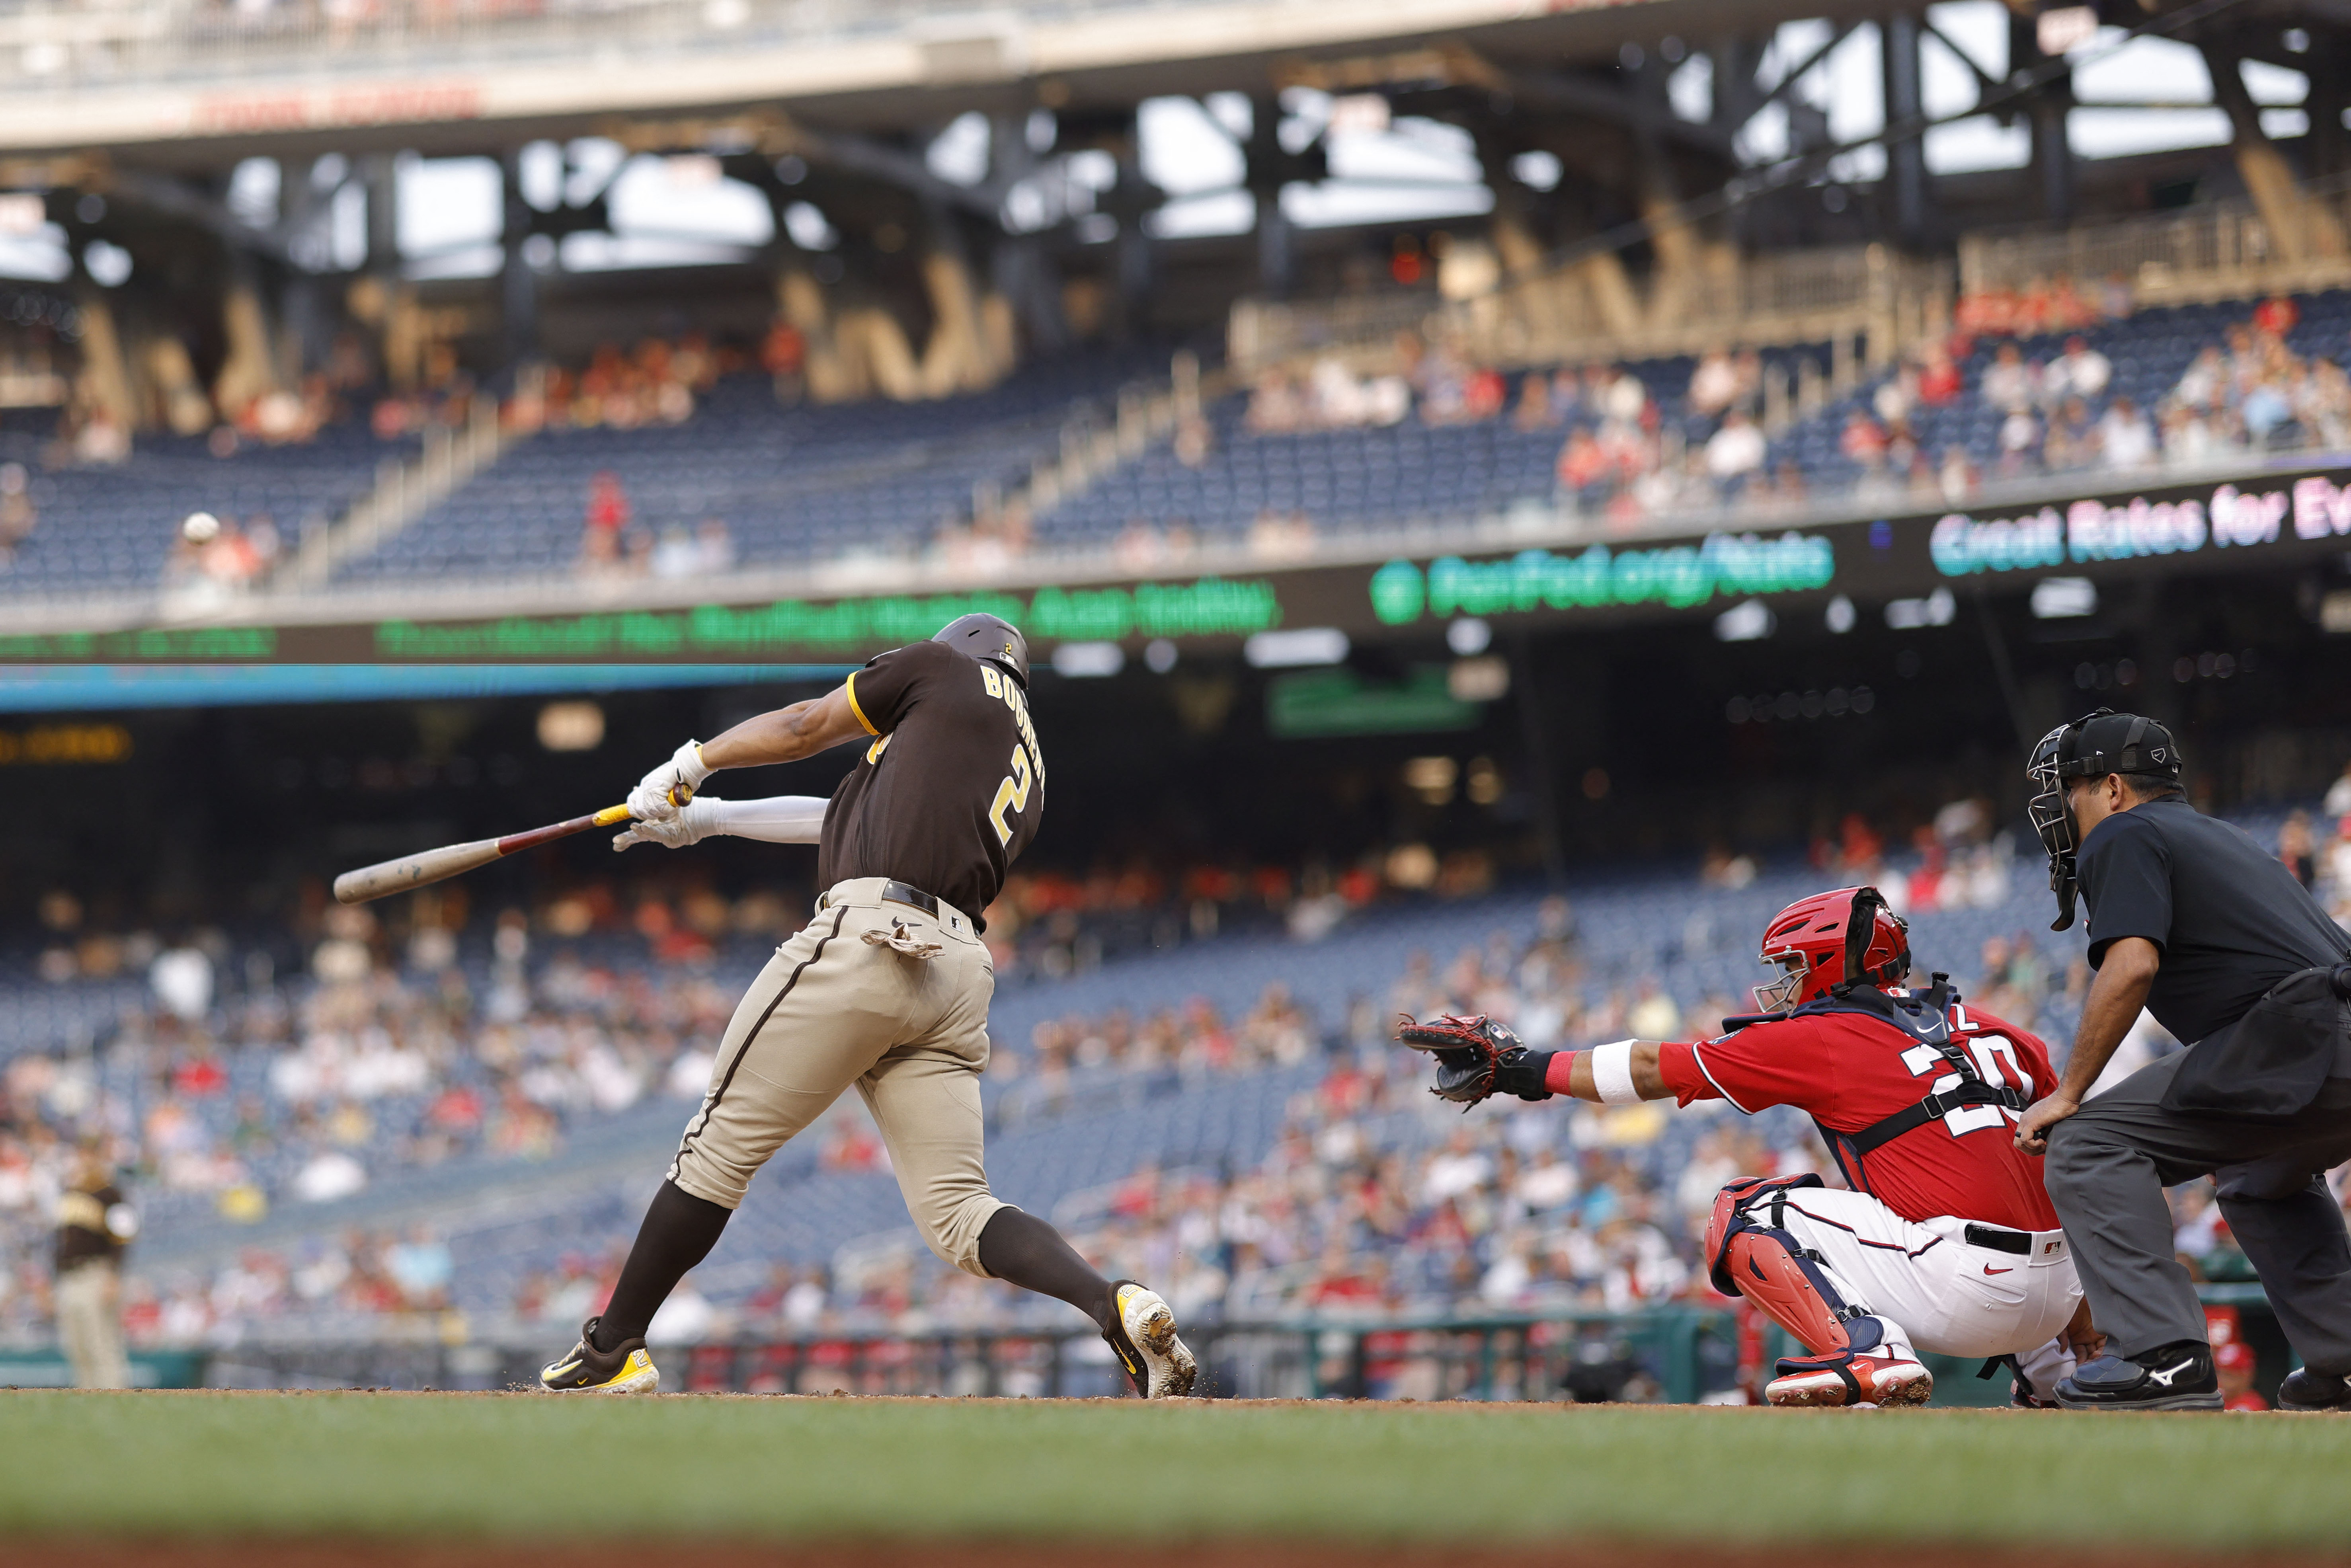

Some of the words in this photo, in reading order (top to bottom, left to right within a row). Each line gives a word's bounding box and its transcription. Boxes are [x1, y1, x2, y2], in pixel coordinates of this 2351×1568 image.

[1930, 506, 2065, 576] Great
[2068, 497, 2208, 563] Rates
[2210, 484, 2289, 548] for
[1005, 643, 1013, 655] 2
[989, 743, 1032, 850] 2
[1898, 1034, 2034, 1139] 20
[1119, 1285, 1137, 1298] 2
[633, 1349, 648, 1369] 2
